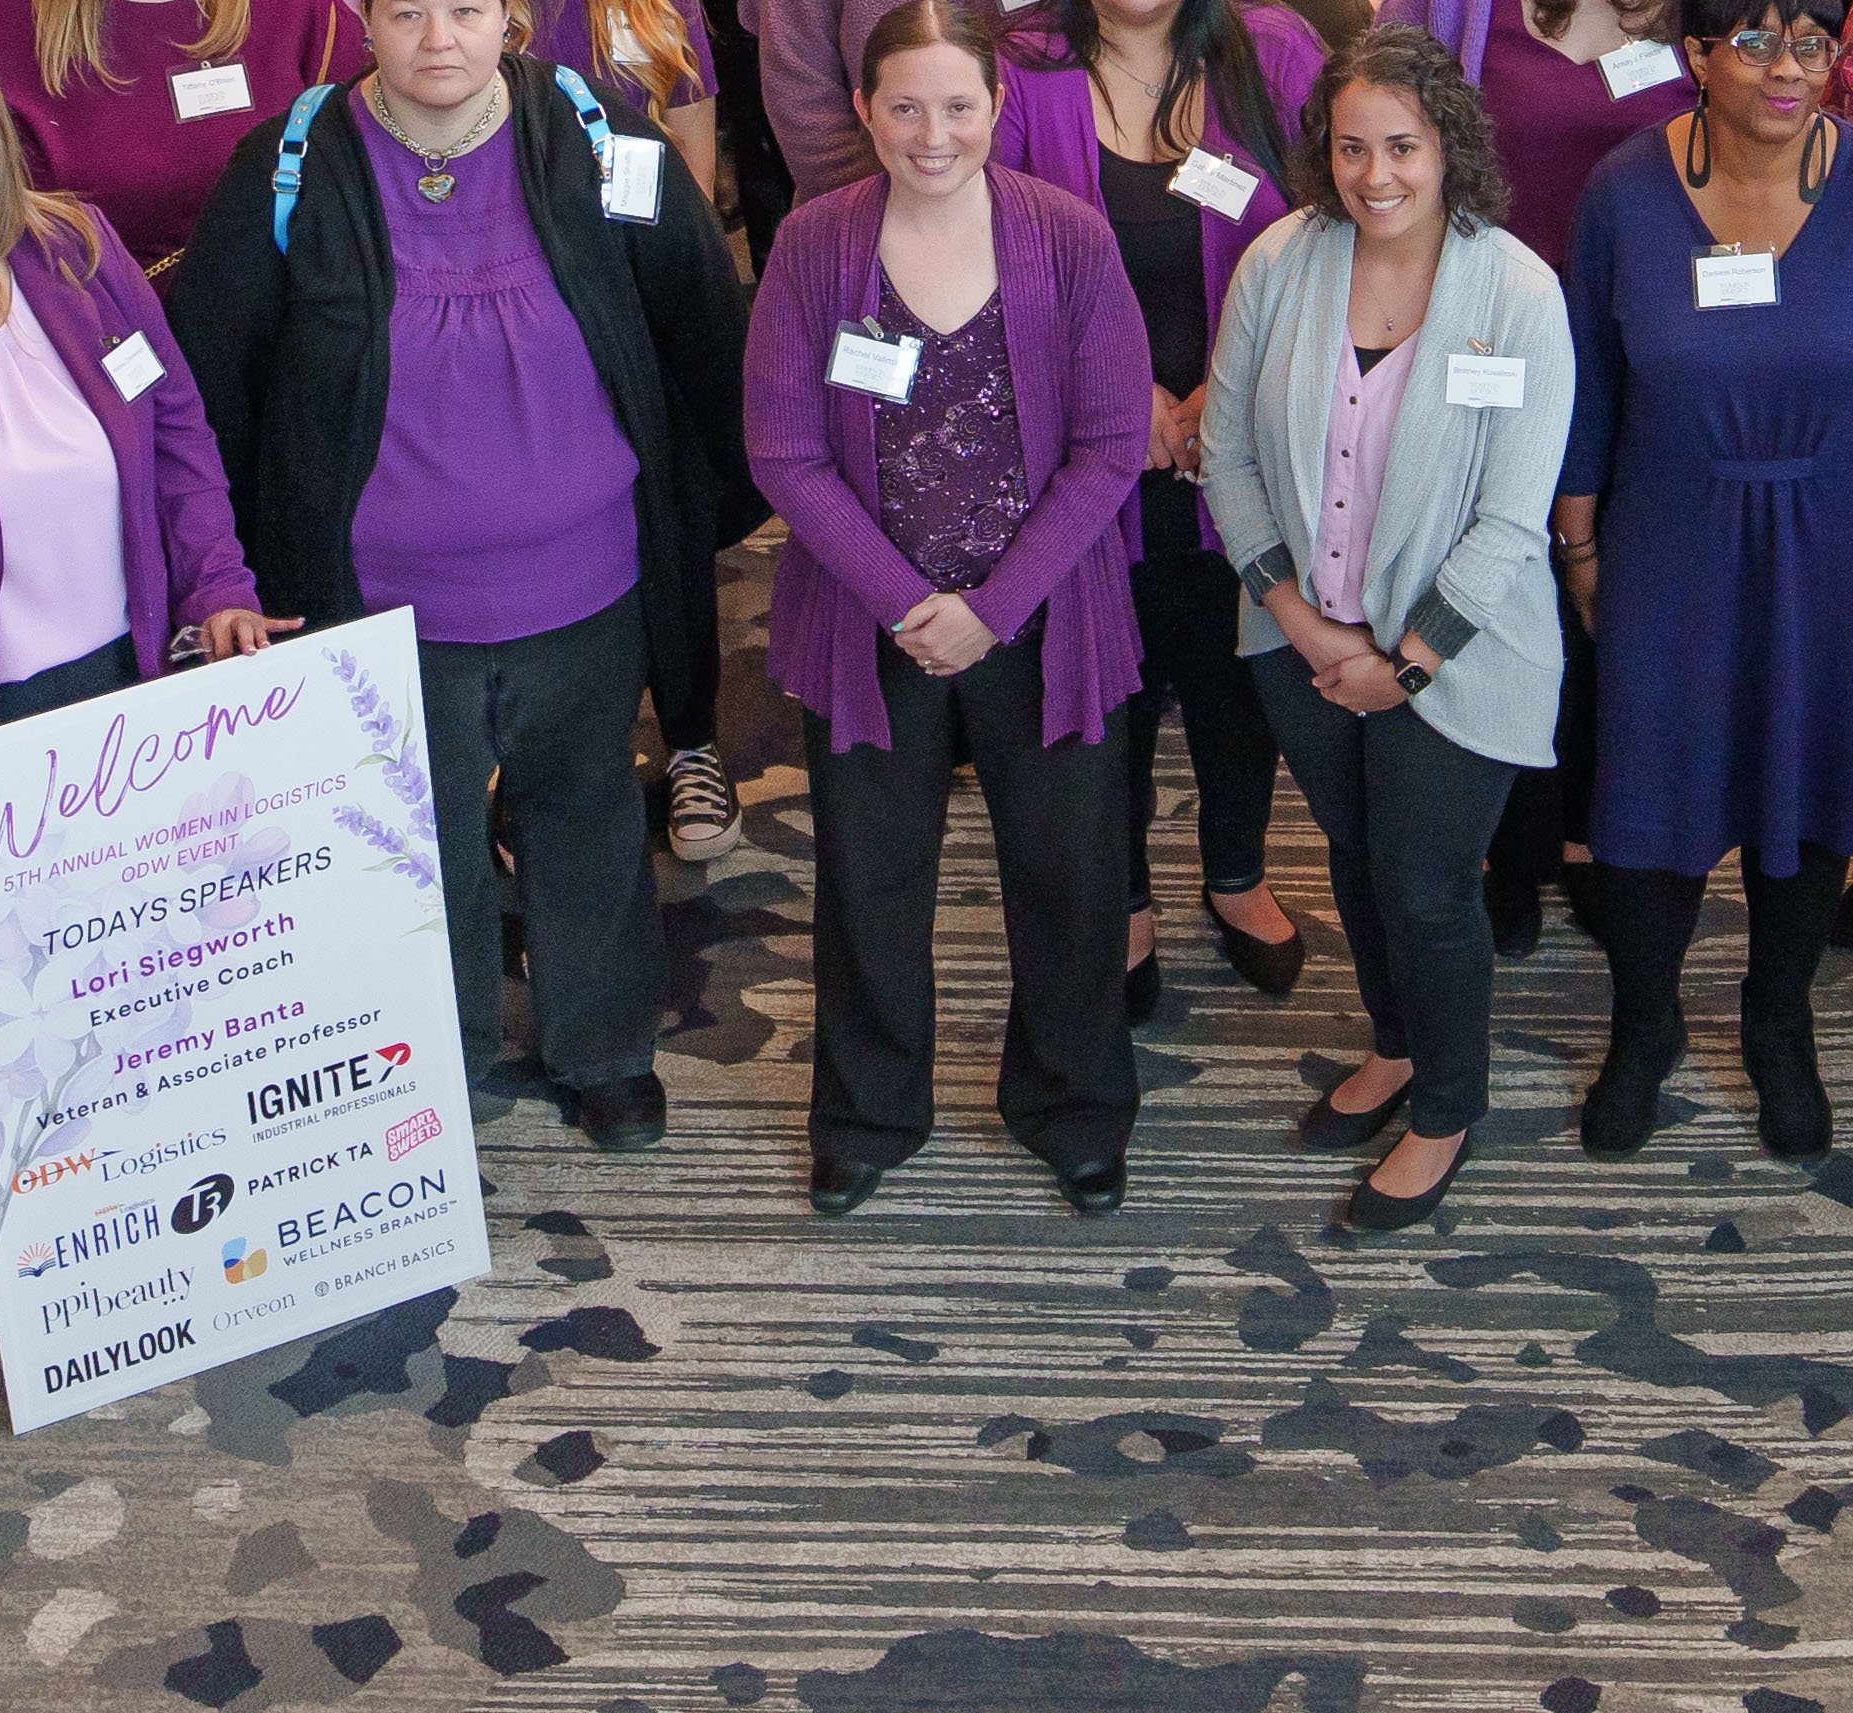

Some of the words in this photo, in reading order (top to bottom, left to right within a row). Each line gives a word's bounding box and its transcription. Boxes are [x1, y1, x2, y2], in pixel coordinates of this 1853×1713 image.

[1215, 171, 1248, 192] Martinez
[842, 345, 871, 358] Rachel
[3, 867, 42, 893] 5TH
[48, 840, 128, 880] ANNUAL
[134, 814, 213, 853] WOMEN
[219, 806, 238, 827] IN
[244, 773, 348, 820] LOGISTICS
[120, 858, 170, 885] ODW
[176, 832, 240, 868] EVENT
[42, 896, 168, 956] TODAYS
[178, 845, 334, 914] SPEAKERS
[70, 960, 129, 1000] Lori
[138, 912, 296, 977] Siegworth
[89, 978, 210, 1028] Executive
[217, 949, 295, 986] Coach
[36, 1091, 129, 1131] Veteran
[135, 1080, 150, 1100] &
[156, 1044, 268, 1093] Associate
[274, 1008, 382, 1054] Professor
[113, 1028, 216, 1076] Jeremy
[224, 1000, 306, 1040] Banta
[246, 1052, 373, 1125] IGNITE
[252, 1113, 321, 1144] INDUSTRIAL
[323, 1080, 417, 1120] PROFESSIONALS
[386, 1108, 438, 1145] SMART
[387, 1120, 443, 1162] SWEETS
[10, 1146, 98, 1195] ODW
[101, 1126, 228, 1183] Logistics
[248, 1152, 340, 1196] PATRICK
[346, 1142, 374, 1163] TA
[55, 1204, 161, 1270] ENRICH
[278, 1168, 447, 1248] BEACON
[283, 1228, 374, 1268] WELLNESS
[334, 1258, 398, 1291] BRANCH
[401, 1239, 456, 1270] BASICS
[212, 1291, 297, 1332] Orveon
[44, 1318, 196, 1395] DAILYLOOK
